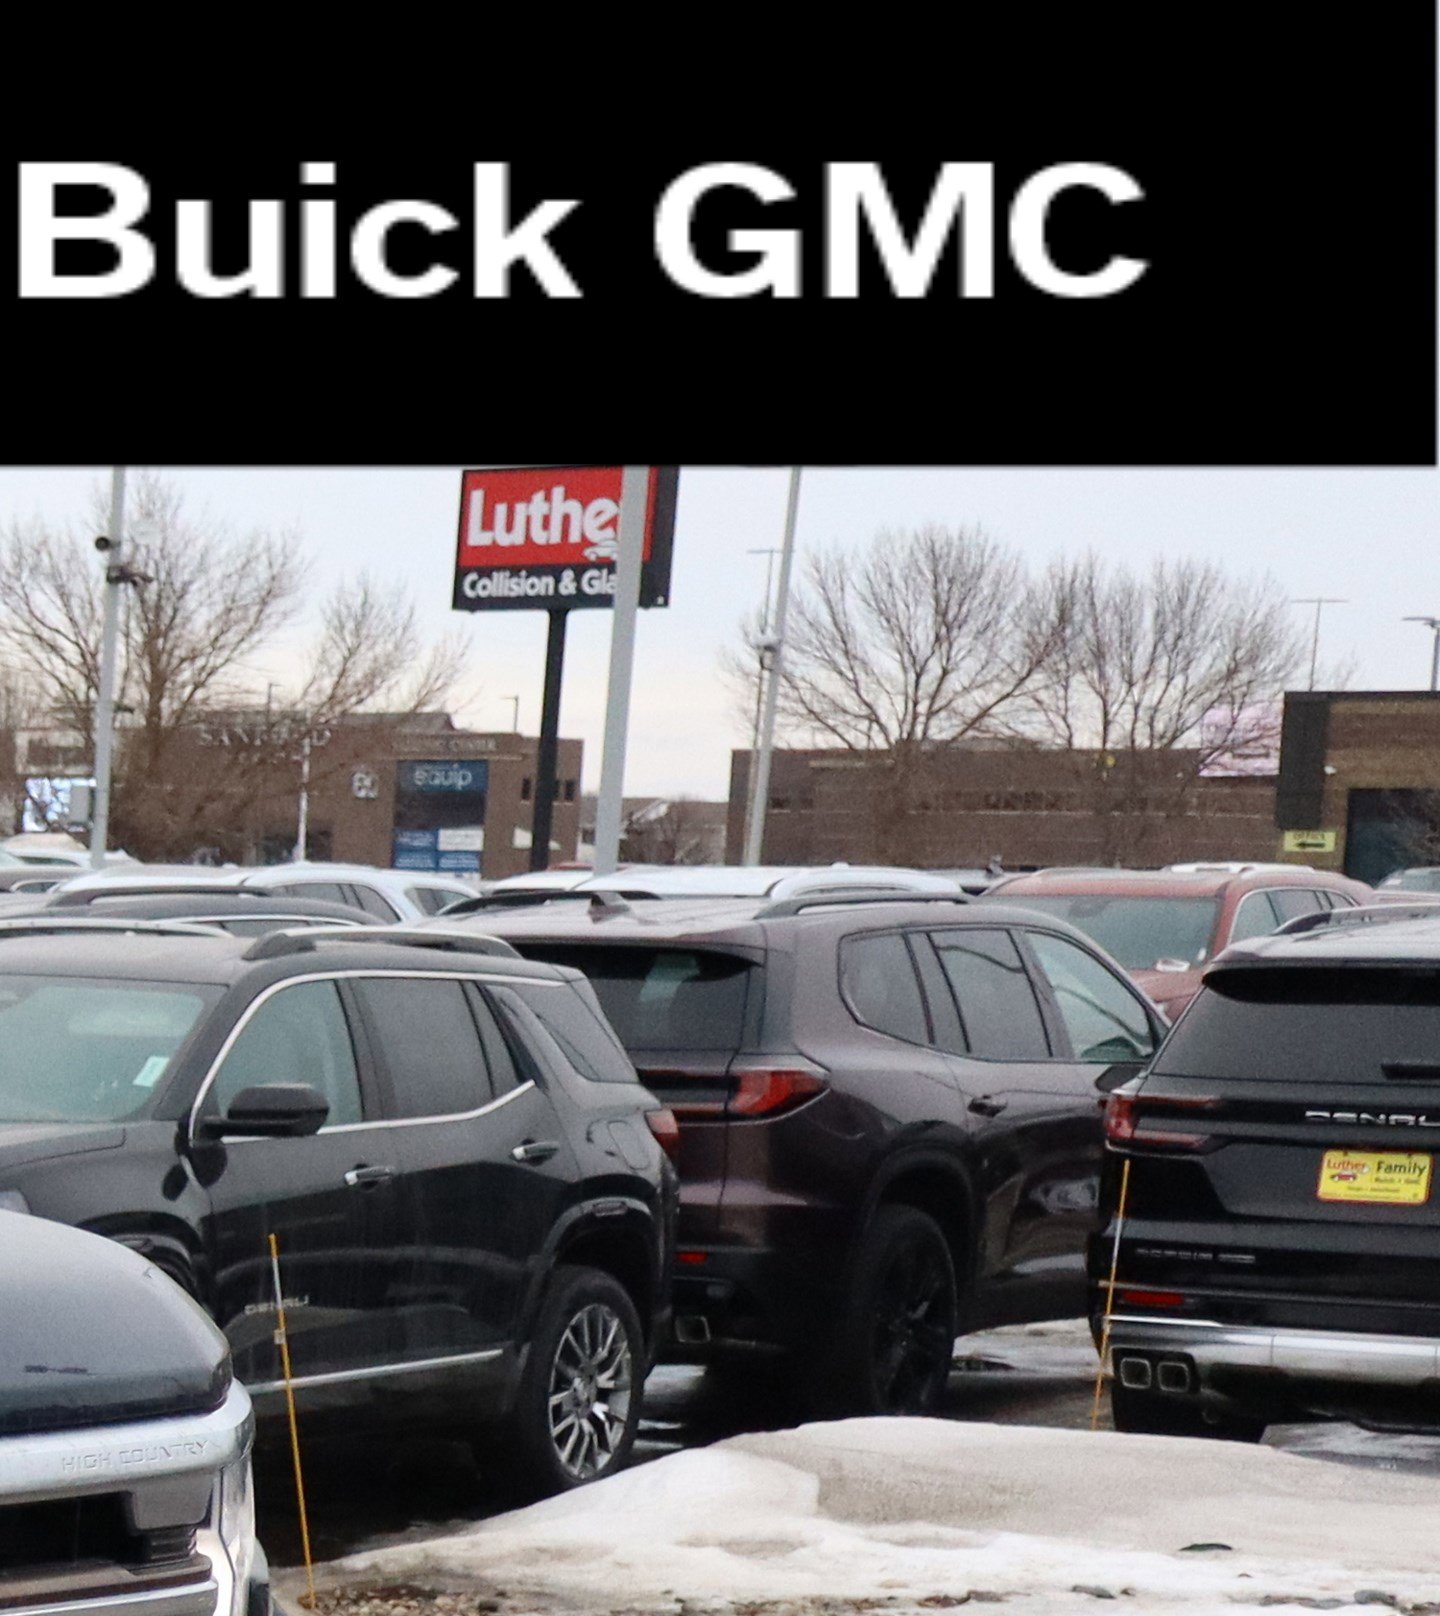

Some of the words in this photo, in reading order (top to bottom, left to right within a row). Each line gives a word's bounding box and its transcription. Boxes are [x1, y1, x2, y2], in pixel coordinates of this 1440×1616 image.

[467, 485, 621, 547] Luthe
[463, 570, 555, 599] Collision
[558, 568, 577, 597] &
[1376, 1160, 1427, 1177] Family
[62, 1452, 111, 1473] HIGH
[118, 1440, 208, 1465] COUNTRY
